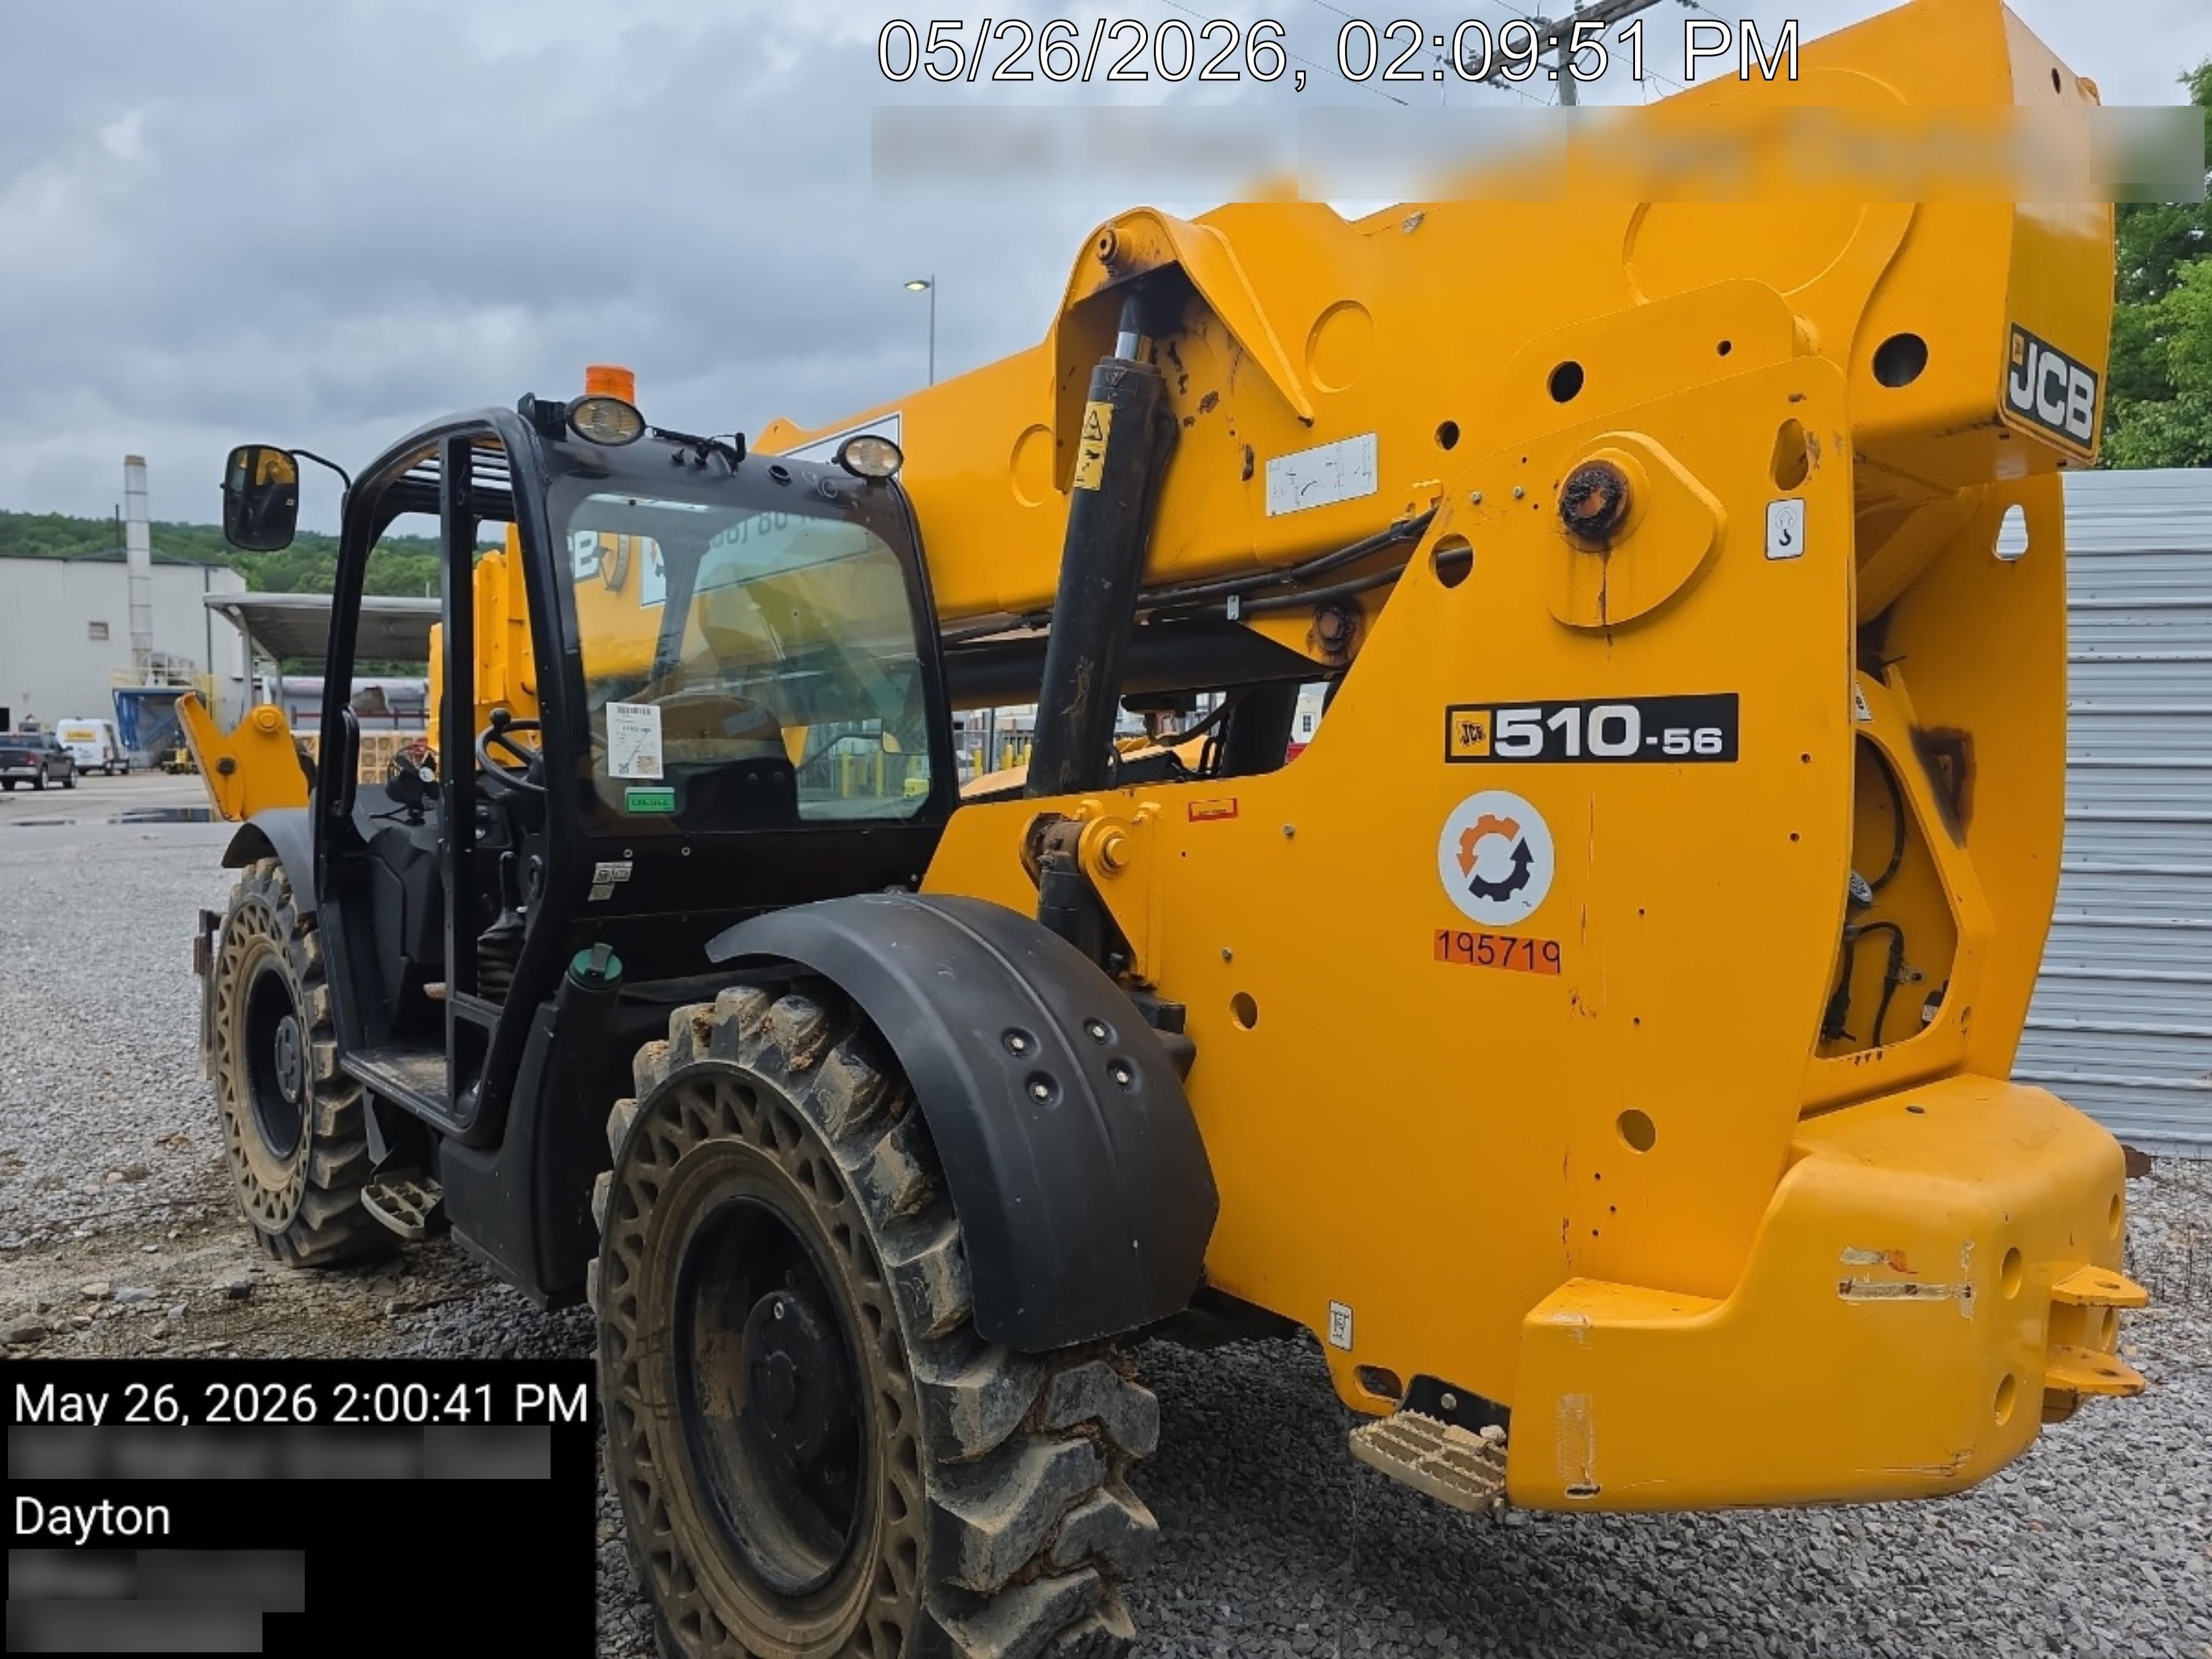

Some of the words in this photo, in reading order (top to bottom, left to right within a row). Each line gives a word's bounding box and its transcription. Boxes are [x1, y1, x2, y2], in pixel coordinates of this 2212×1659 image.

[2009, 342, 2095, 439] JCB
[1494, 705, 1723, 757] 510-56
[1438, 930, 1561, 974] 195719
